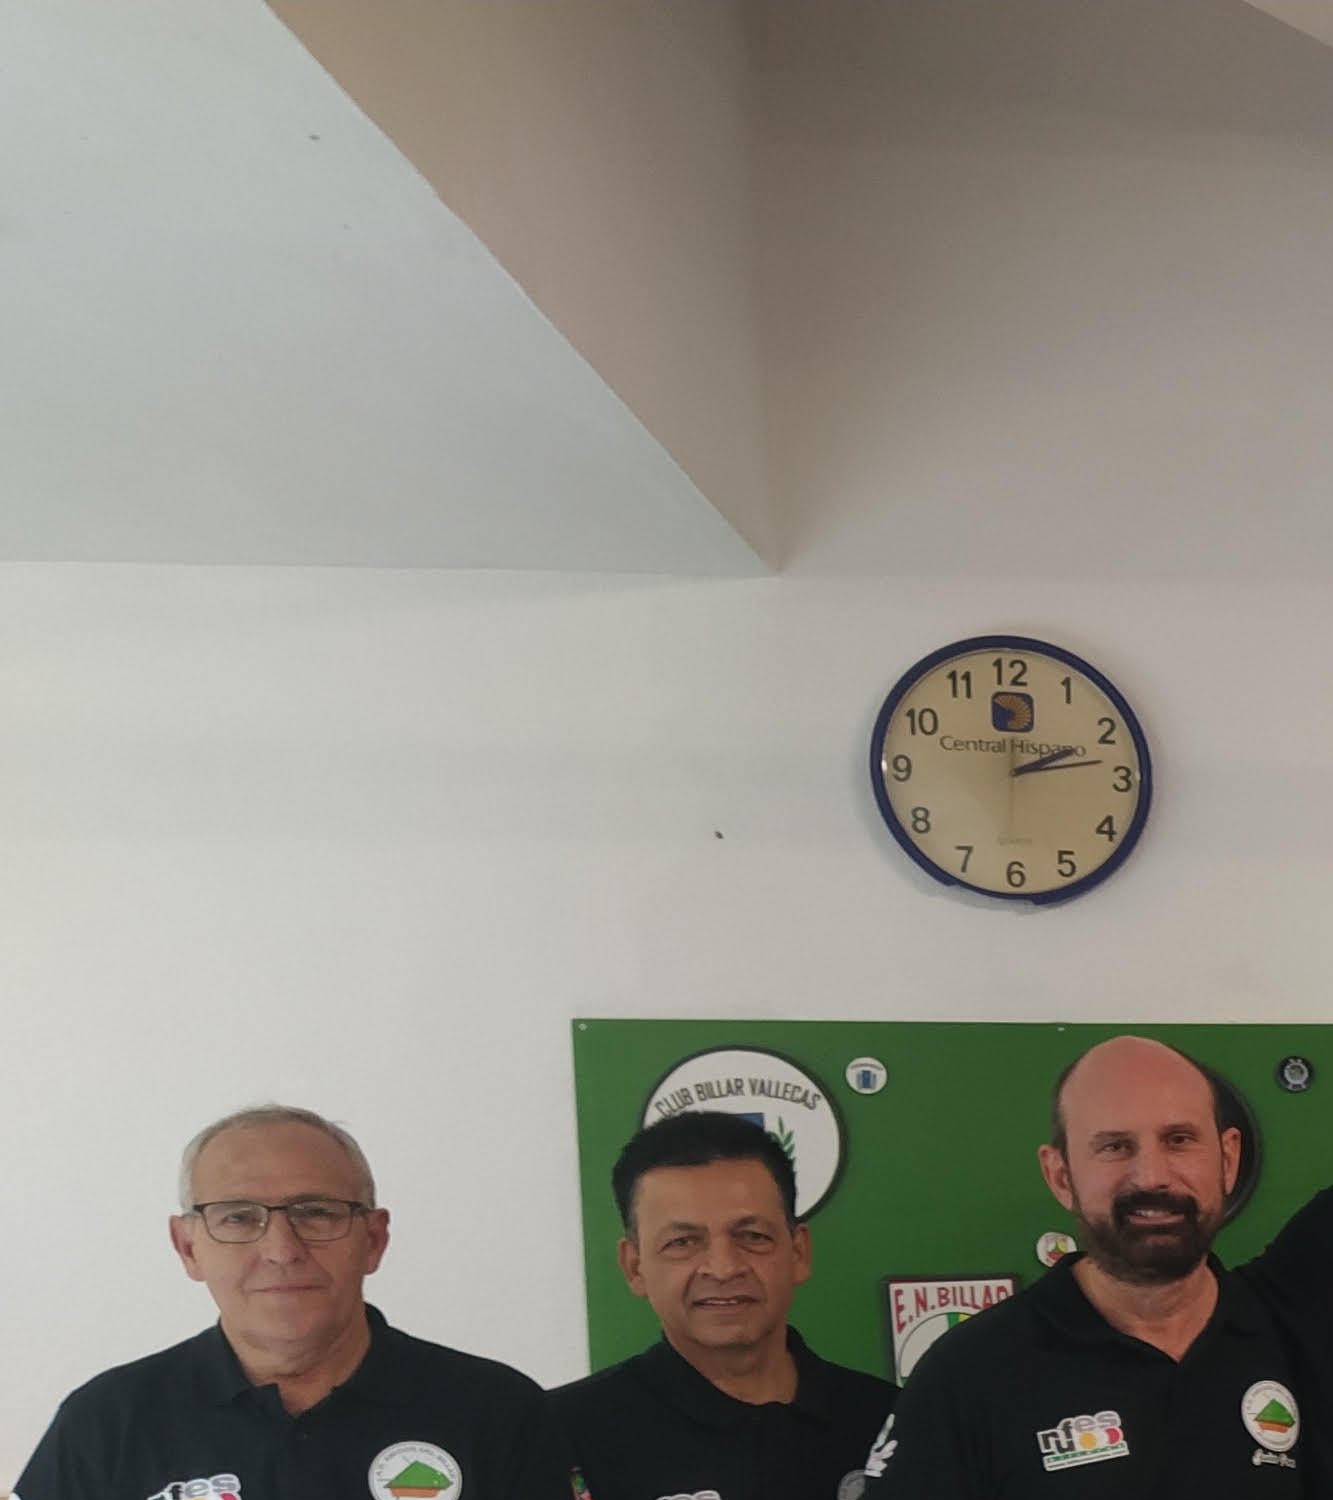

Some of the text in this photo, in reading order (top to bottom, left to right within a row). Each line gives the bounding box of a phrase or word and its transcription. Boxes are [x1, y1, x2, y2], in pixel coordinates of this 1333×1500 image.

[947, 670, 973, 699] 11
[992, 657, 1029, 687] 12
[1061, 676, 1073, 704] 1
[905, 708, 939, 736] 10
[1097, 717, 1116, 745] 2
[939, 735, 1006, 753] Central
[892, 754, 912, 782] 9
[1112, 766, 1133, 793] 3
[911, 806, 932, 834] 8
[1096, 815, 1117, 842] 4
[955, 845, 974, 873] 7
[1057, 850, 1077, 878] 5
[1006, 861, 1026, 888] 6
[655, 1078, 822, 1118] CLUB BILLAR VALLECAS
